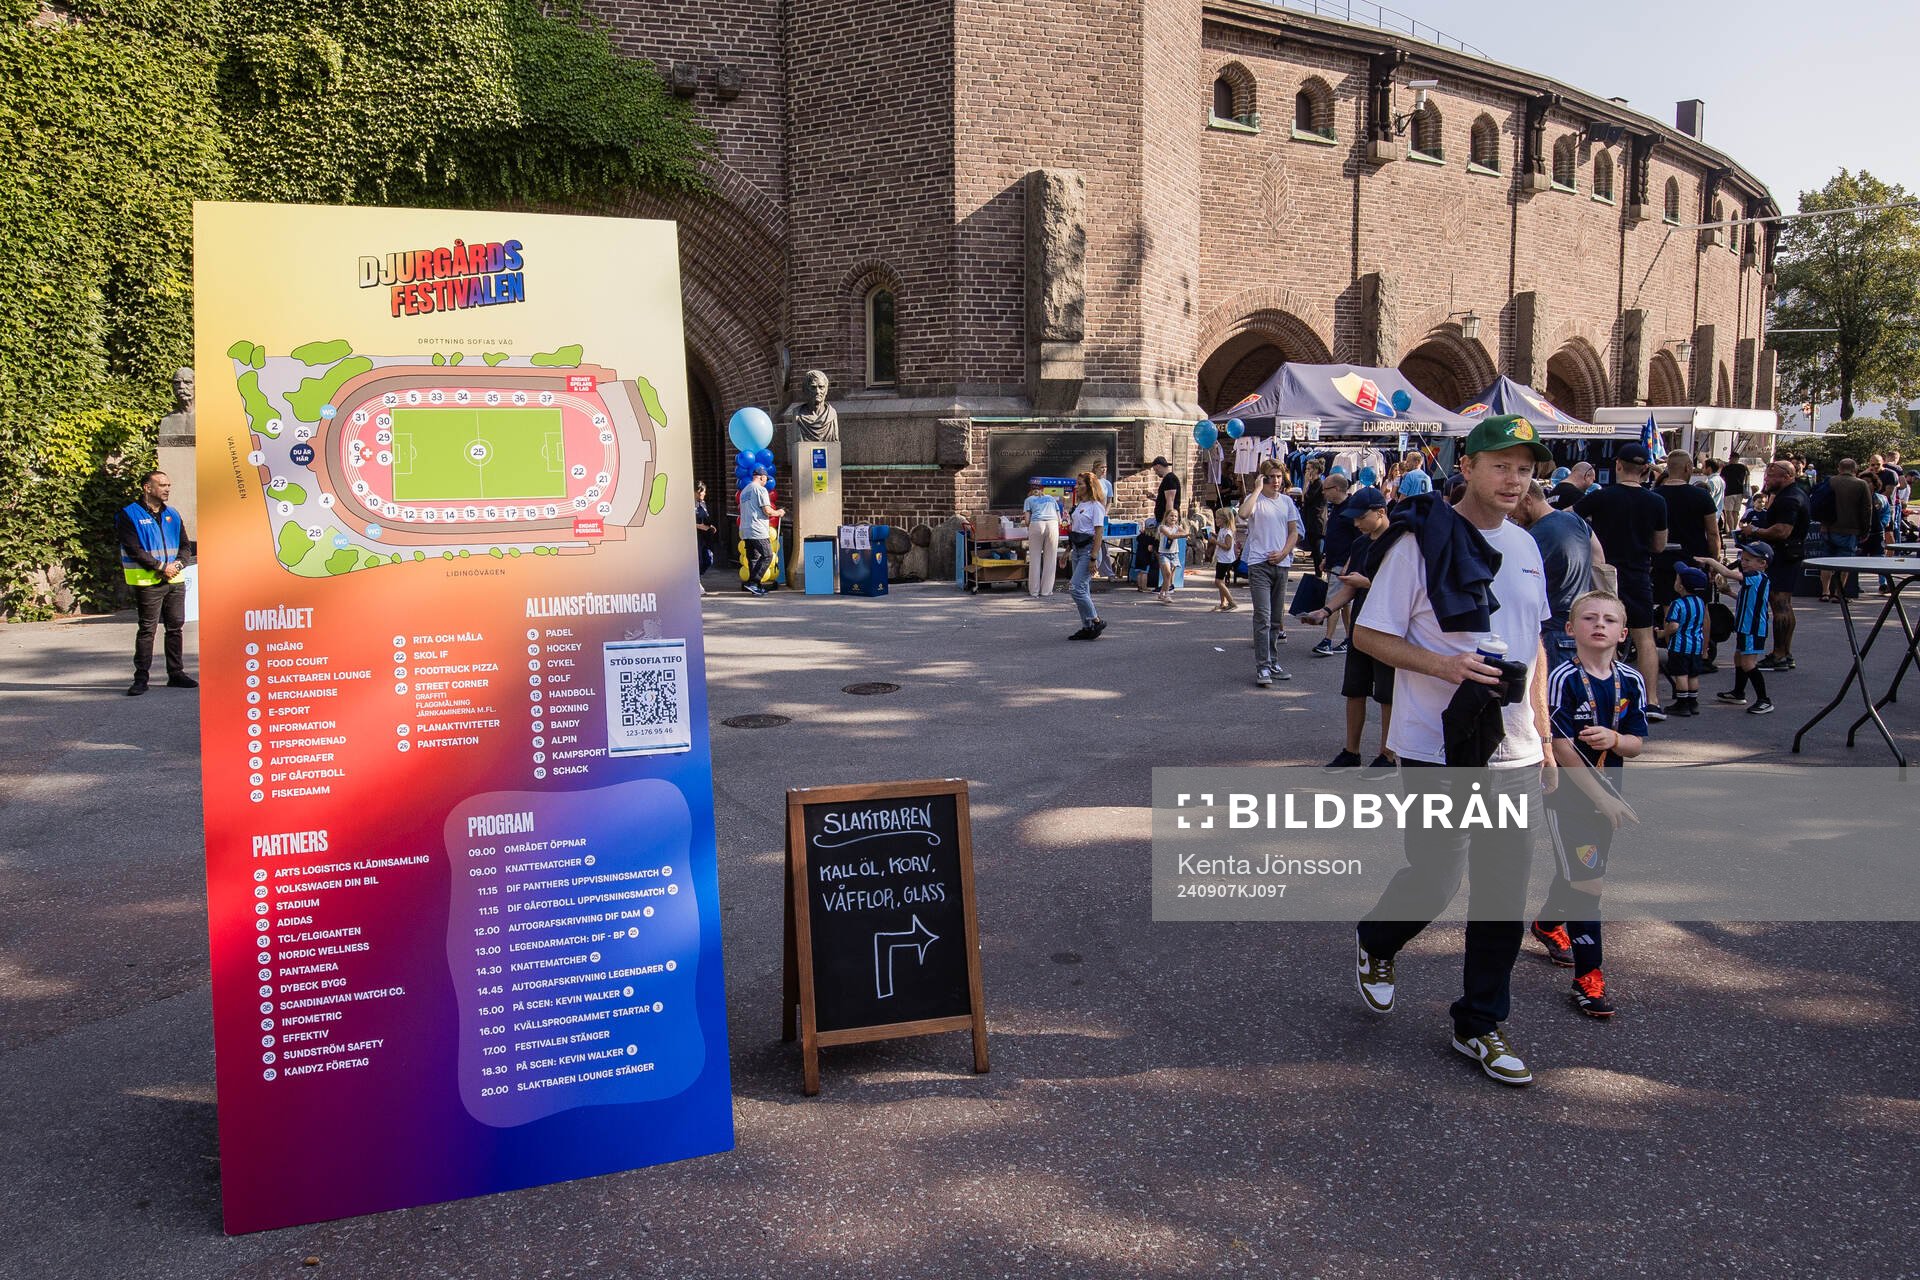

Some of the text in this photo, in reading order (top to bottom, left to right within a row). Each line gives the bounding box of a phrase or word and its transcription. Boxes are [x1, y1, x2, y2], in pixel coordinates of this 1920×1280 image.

[359, 239, 524, 288] DJURGÅRDS
[391, 272, 525, 317] FESTIVALEN
[473, 448, 485, 456] 25
[227, 436, 247, 499] VALHALLAVÄGEN
[526, 592, 656, 618] ALLIANSFÖRENINGAR
[245, 604, 314, 631] OMRÅDET
[413, 632, 483, 644] RITA OCH MÅLA
[546, 628, 573, 637] PADEL
[267, 641, 303, 652] INGÅNG
[547, 643, 582, 652] HOCKEY
[414, 650, 448, 660] SKOL IF
[610, 657, 634, 666] STÖD
[267, 657, 328, 668] FOOD COURT
[547, 659, 575, 667] CYKEL
[414, 664, 498, 675] FOODTRUCK PIZZA
[267, 670, 371, 684] SLAKTBAREN LOUNGE
[548, 674, 570, 683] GOLF
[415, 679, 488, 691] STREET CORNER
[268, 688, 337, 700] MERCHANDISE
[415, 692, 446, 700] GRAFFITI
[549, 688, 596, 698] HANDBOLL
[416, 699, 471, 708] FLAGGMÅLNING
[550, 704, 589, 713] BOXNING
[269, 706, 310, 716] E-SPORT
[416, 708, 476, 717] JÄRNKAMINERNA
[269, 721, 336, 733] INFORMATION
[417, 720, 500, 732] PLANAKTIVITETER
[551, 720, 580, 728] BANDY
[626, 728, 653, 736] 123-176
[269, 736, 346, 748] TIPSPROMENAD
[418, 736, 478, 748] PANTSTATION
[551, 735, 577, 744] ALPIN
[270, 753, 334, 765] AUTOGRAFER
[552, 748, 606, 760] KAMPSPORT
[271, 769, 345, 782] DIF GÅFOTBOLL
[553, 765, 588, 775] SCHACK
[272, 786, 330, 798] FISKEDAMM
[468, 812, 534, 837] PROGRAM
[823, 803, 931, 833] SLAKTBAREN
[252, 830, 328, 857] PARTNERS
[468, 838, 586, 856] 09.00 OMRÅDET ÖPPNAR
[275, 855, 429, 878] ARTS LOGISTICS KLÄDINSAMLING
[470, 858, 582, 876] 09.00 KNATTEMATCHER
[820, 854, 935, 882] KALL ÖL, KORV,
[275, 876, 379, 894] VOLKSWAGEN DIN BIL
[478, 869, 659, 896] 11.15 DIF PANTHERS UPPVISNINGSMATCH
[904, 883, 945, 903] GLASS
[276, 898, 319, 910] STADIUM
[478, 888, 664, 915] 11.15 DIF GÅFOTBOLL UPPVISNINGSMATCH
[277, 916, 312, 927] ADIDAS
[474, 910, 640, 936] 12.00 AUTOGRAFSKRIVNING DIF DAM
[278, 927, 361, 943] TCL/ELGIGANTEN
[475, 931, 625, 956] 13.00 LEGENDARMATCH: DIF BP
[279, 942, 370, 960] NORDIC WELLNESS
[280, 962, 338, 976] PANTAMERA
[476, 955, 587, 976] 14.30 KNATTEMATCHER
[280, 978, 346, 993] DYBECK BYGG
[477, 964, 664, 996] 14.45 AUTOGRAFSKRIVNING LEGENDARER
[280, 987, 405, 1010] SCANDINAVIAN WATCH CO.
[478, 990, 620, 1016] 15.00 PÅ SCEN: KEVIN WALKER
[282, 1012, 342, 1026] INFOMETRIC
[480, 1005, 650, 1036] 16.00 KVÄLLSPROGRAMMET STARTAR
[283, 1030, 329, 1042] EFFEKTIV
[284, 1039, 384, 1059] SUNDSTRÖM SAFETY
[483, 1030, 610, 1056] 17.00 FESTIVALEN STÄNGER
[284, 1058, 369, 1076] KANDYZ FÖRETAG
[482, 1048, 624, 1076] 18.30 PÅ SCEN: KEVIN WALKER
[482, 1063, 654, 1096] 20.00 SLAKTBAREN LOUNGE STÄNGER
